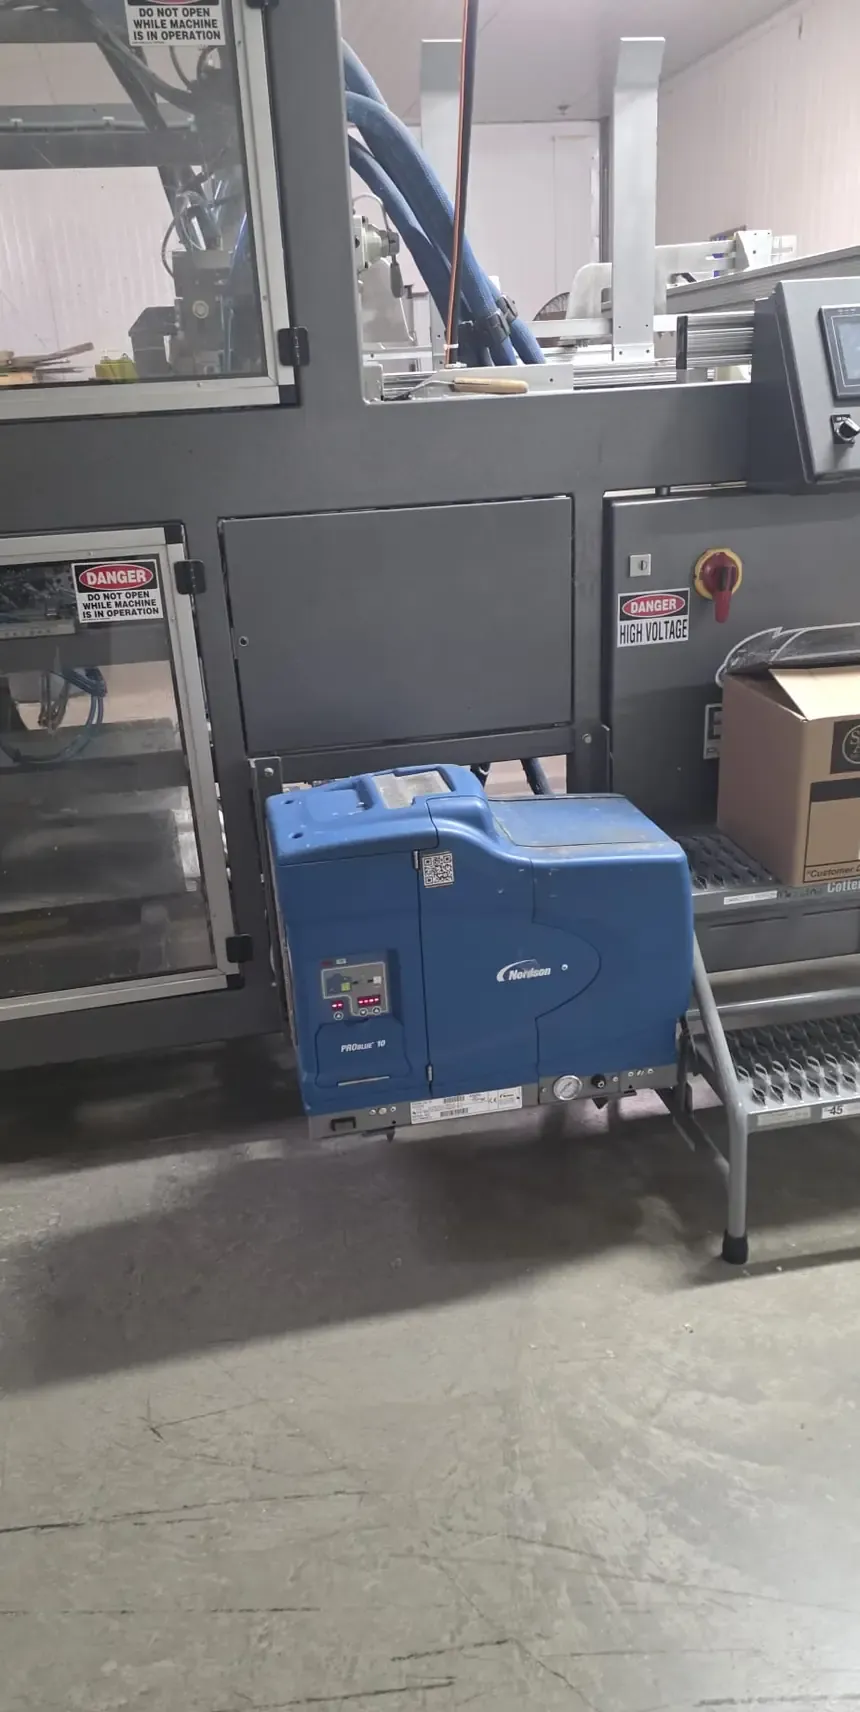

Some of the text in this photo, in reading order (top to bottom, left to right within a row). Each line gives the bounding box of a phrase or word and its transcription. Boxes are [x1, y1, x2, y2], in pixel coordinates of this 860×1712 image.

[139, 8, 210, 17] DO NOT OPEN
[133, 19, 218, 29] WHILE MACHINE
[133, 30, 221, 41] IS IN OPERATION
[86, 569, 147, 586] DANGER
[87, 591, 150, 601] DO NOT OPEN
[82, 599, 157, 610] WHILE MACHINE
[630, 598, 677, 614] DANGER
[106, 607, 159, 617] OPERATION
[620, 619, 688, 645] HIGH VOLTAGE
[827, 880, 860, 893] Cotte
[508, 967, 552, 981] Nordson
[377, 1039, 386, 1048] 10
